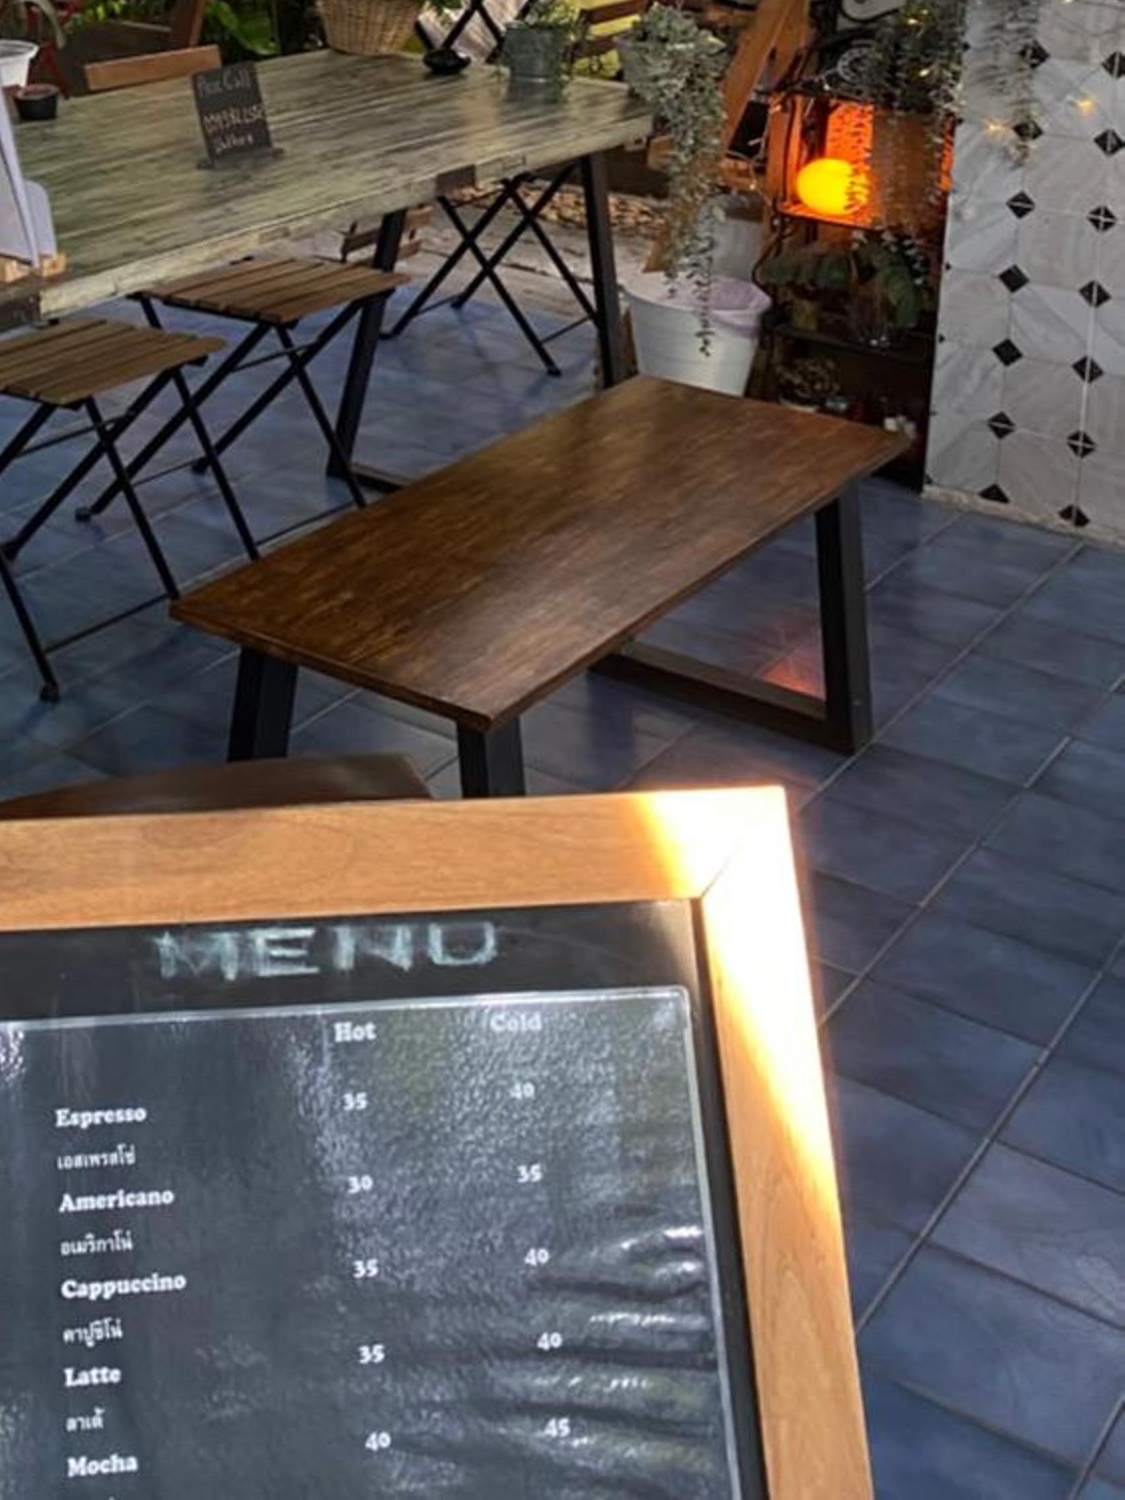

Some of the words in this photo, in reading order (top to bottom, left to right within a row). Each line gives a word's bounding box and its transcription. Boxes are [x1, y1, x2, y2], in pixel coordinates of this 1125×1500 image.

[154, 920, 498, 981] MENU
[333, 1021, 377, 1043] Hot
[488, 1013, 542, 1034] Cold
[343, 1091, 368, 1111] 35
[510, 1081, 535, 1101] 40
[54, 1107, 148, 1130] Espresso
[347, 1174, 374, 1194] 30
[517, 1163, 543, 1184] 35
[58, 1188, 175, 1214] Americano
[524, 1247, 550, 1267] 40
[352, 1258, 379, 1279] 35
[61, 1272, 187, 1301] Cappuccino
[536, 1331, 563, 1351] 40
[358, 1343, 386, 1364] 35
[63, 1366, 122, 1388] Latte
[543, 1417, 571, 1438] 45
[364, 1431, 392, 1451] 40
[67, 1453, 139, 1478] Mocha
